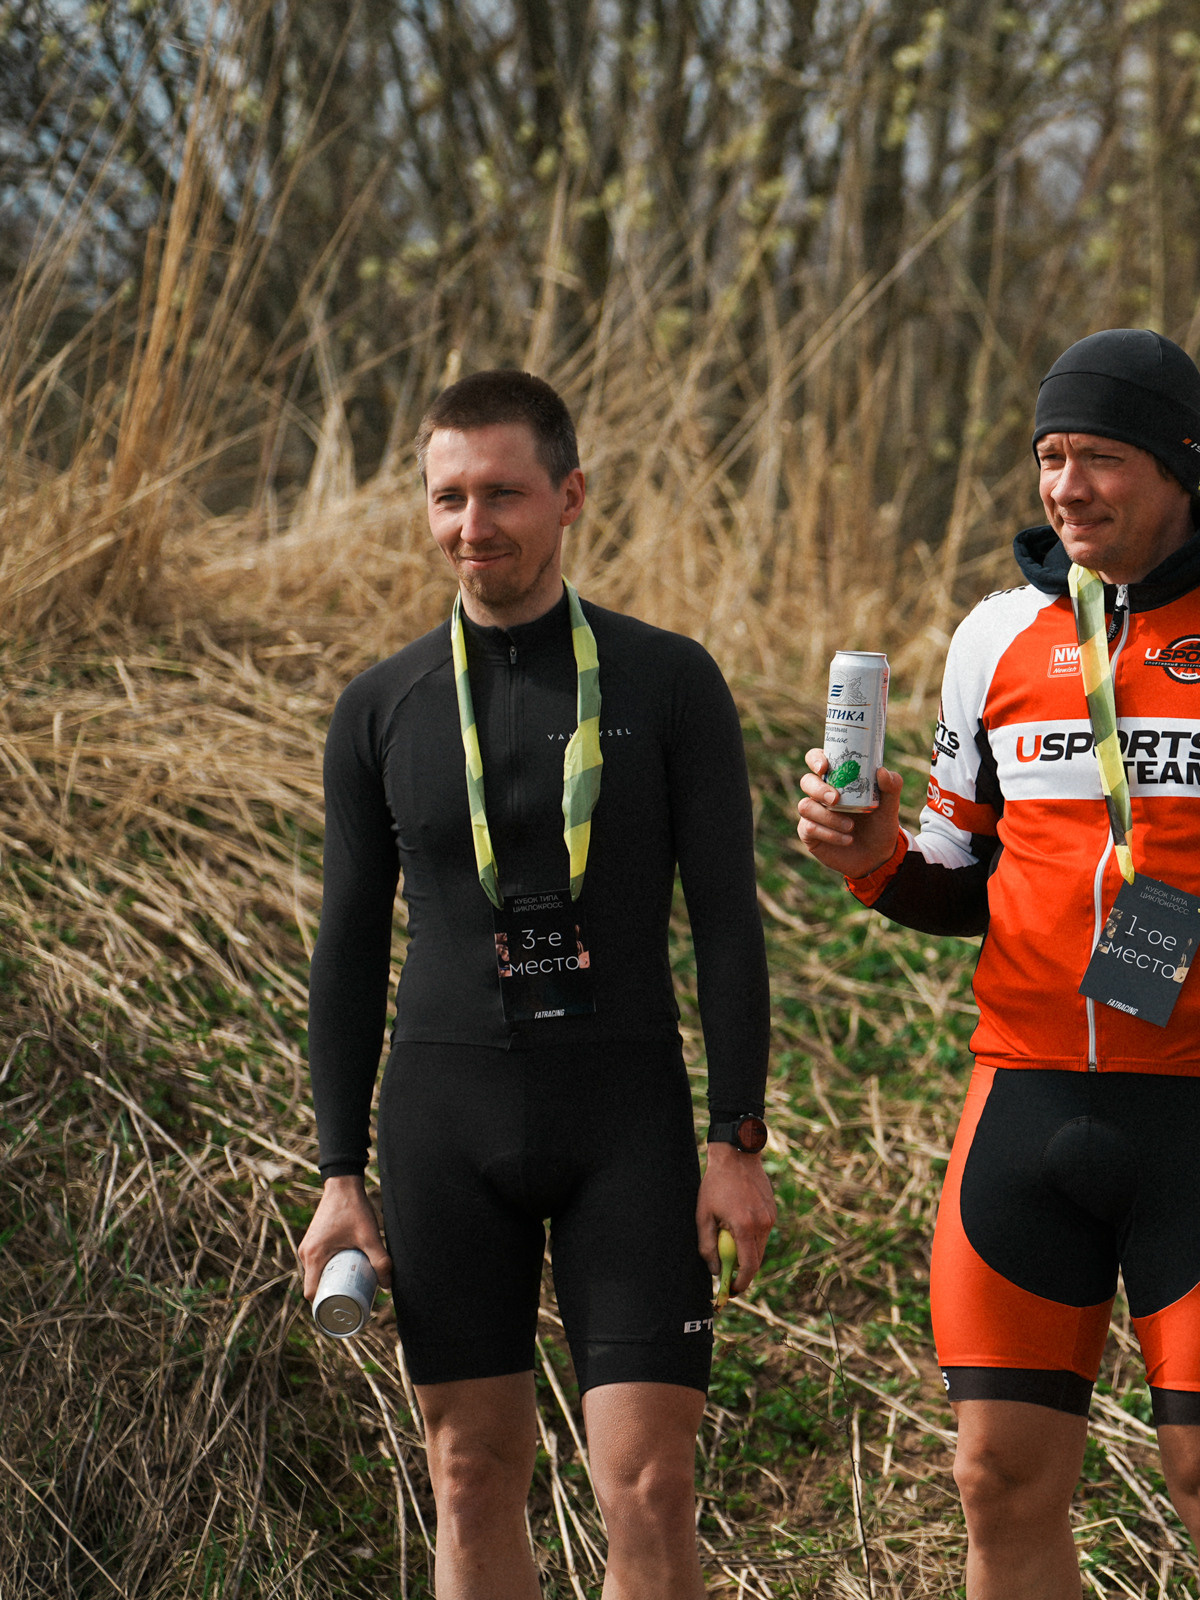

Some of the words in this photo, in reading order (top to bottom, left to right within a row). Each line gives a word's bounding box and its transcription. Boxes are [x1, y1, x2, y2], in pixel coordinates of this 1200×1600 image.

[1054, 647, 1080, 662] NW
[514, 896, 539, 905] КУБОК
[540, 894, 559, 902] ТИПА
[1140, 891, 1190, 916] ЦИКЛОКРОСС
[1145, 885, 1169, 900] КУБОК
[1169, 894, 1189, 907] ТИПА
[512, 901, 564, 913] ЦИКЛОКРОСС
[521, 929, 562, 950] 3-е
[1124, 915, 1177, 951] 1-ое
[509, 956, 580, 977] место
[1107, 942, 1177, 979] место
[534, 1008, 565, 1020] FATRACING
[1106, 998, 1139, 1016] FATRACING
